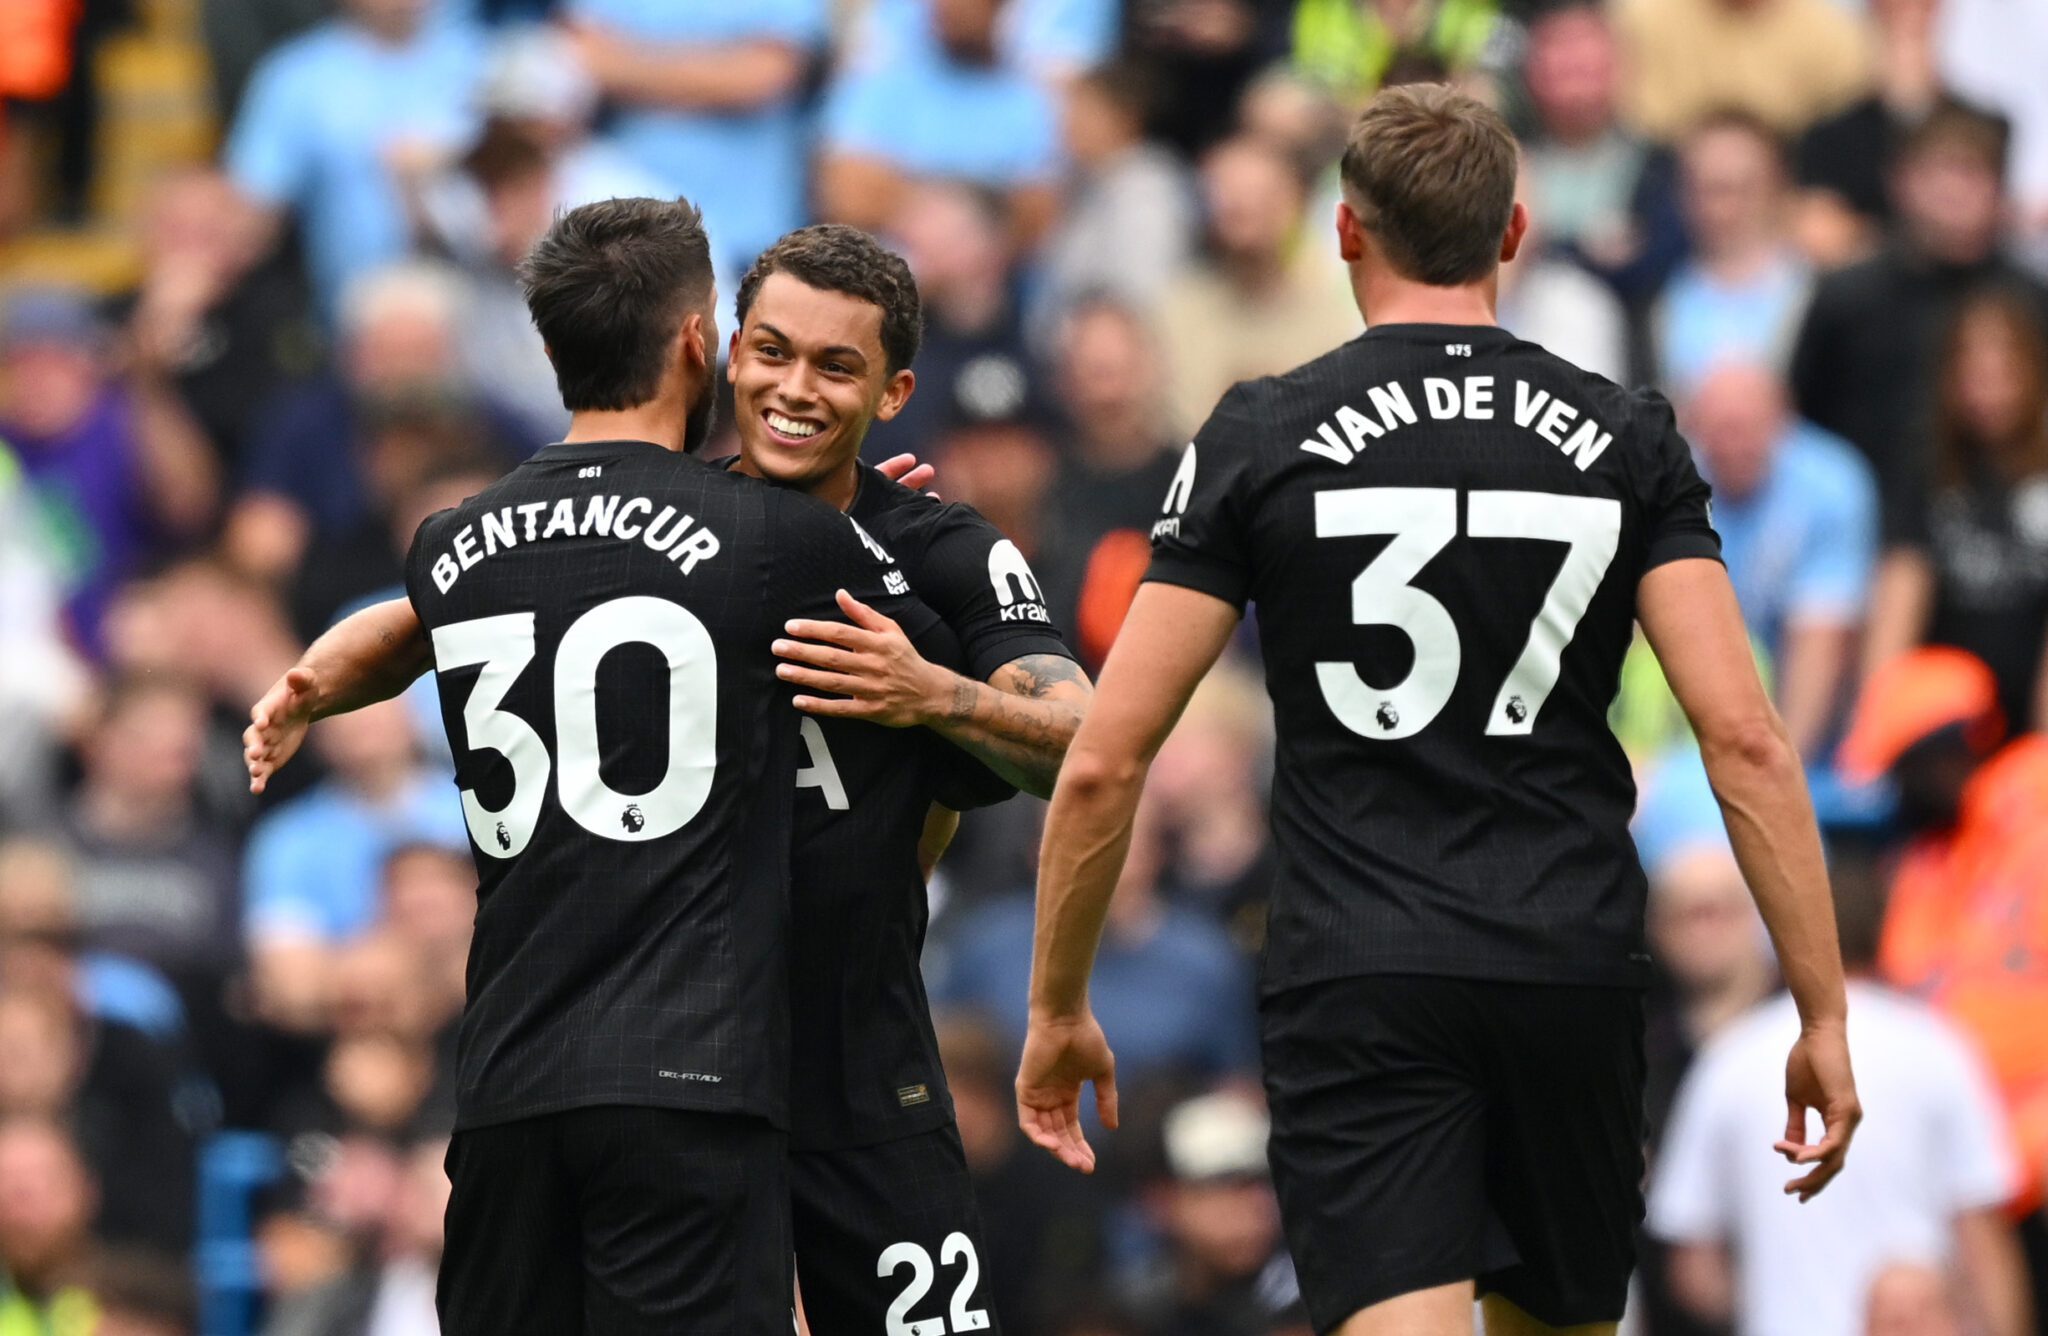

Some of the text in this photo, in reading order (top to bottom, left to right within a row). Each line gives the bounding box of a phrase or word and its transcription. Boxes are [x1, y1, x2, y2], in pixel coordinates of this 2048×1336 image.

[578, 466, 602, 478] 861
[1300, 376, 1613, 472] VAN DE VEN
[431, 495, 720, 594] BENTANCUR
[1314, 487, 1622, 740] 37
[431, 596, 717, 859] 30
[877, 1231, 990, 1336] 22
